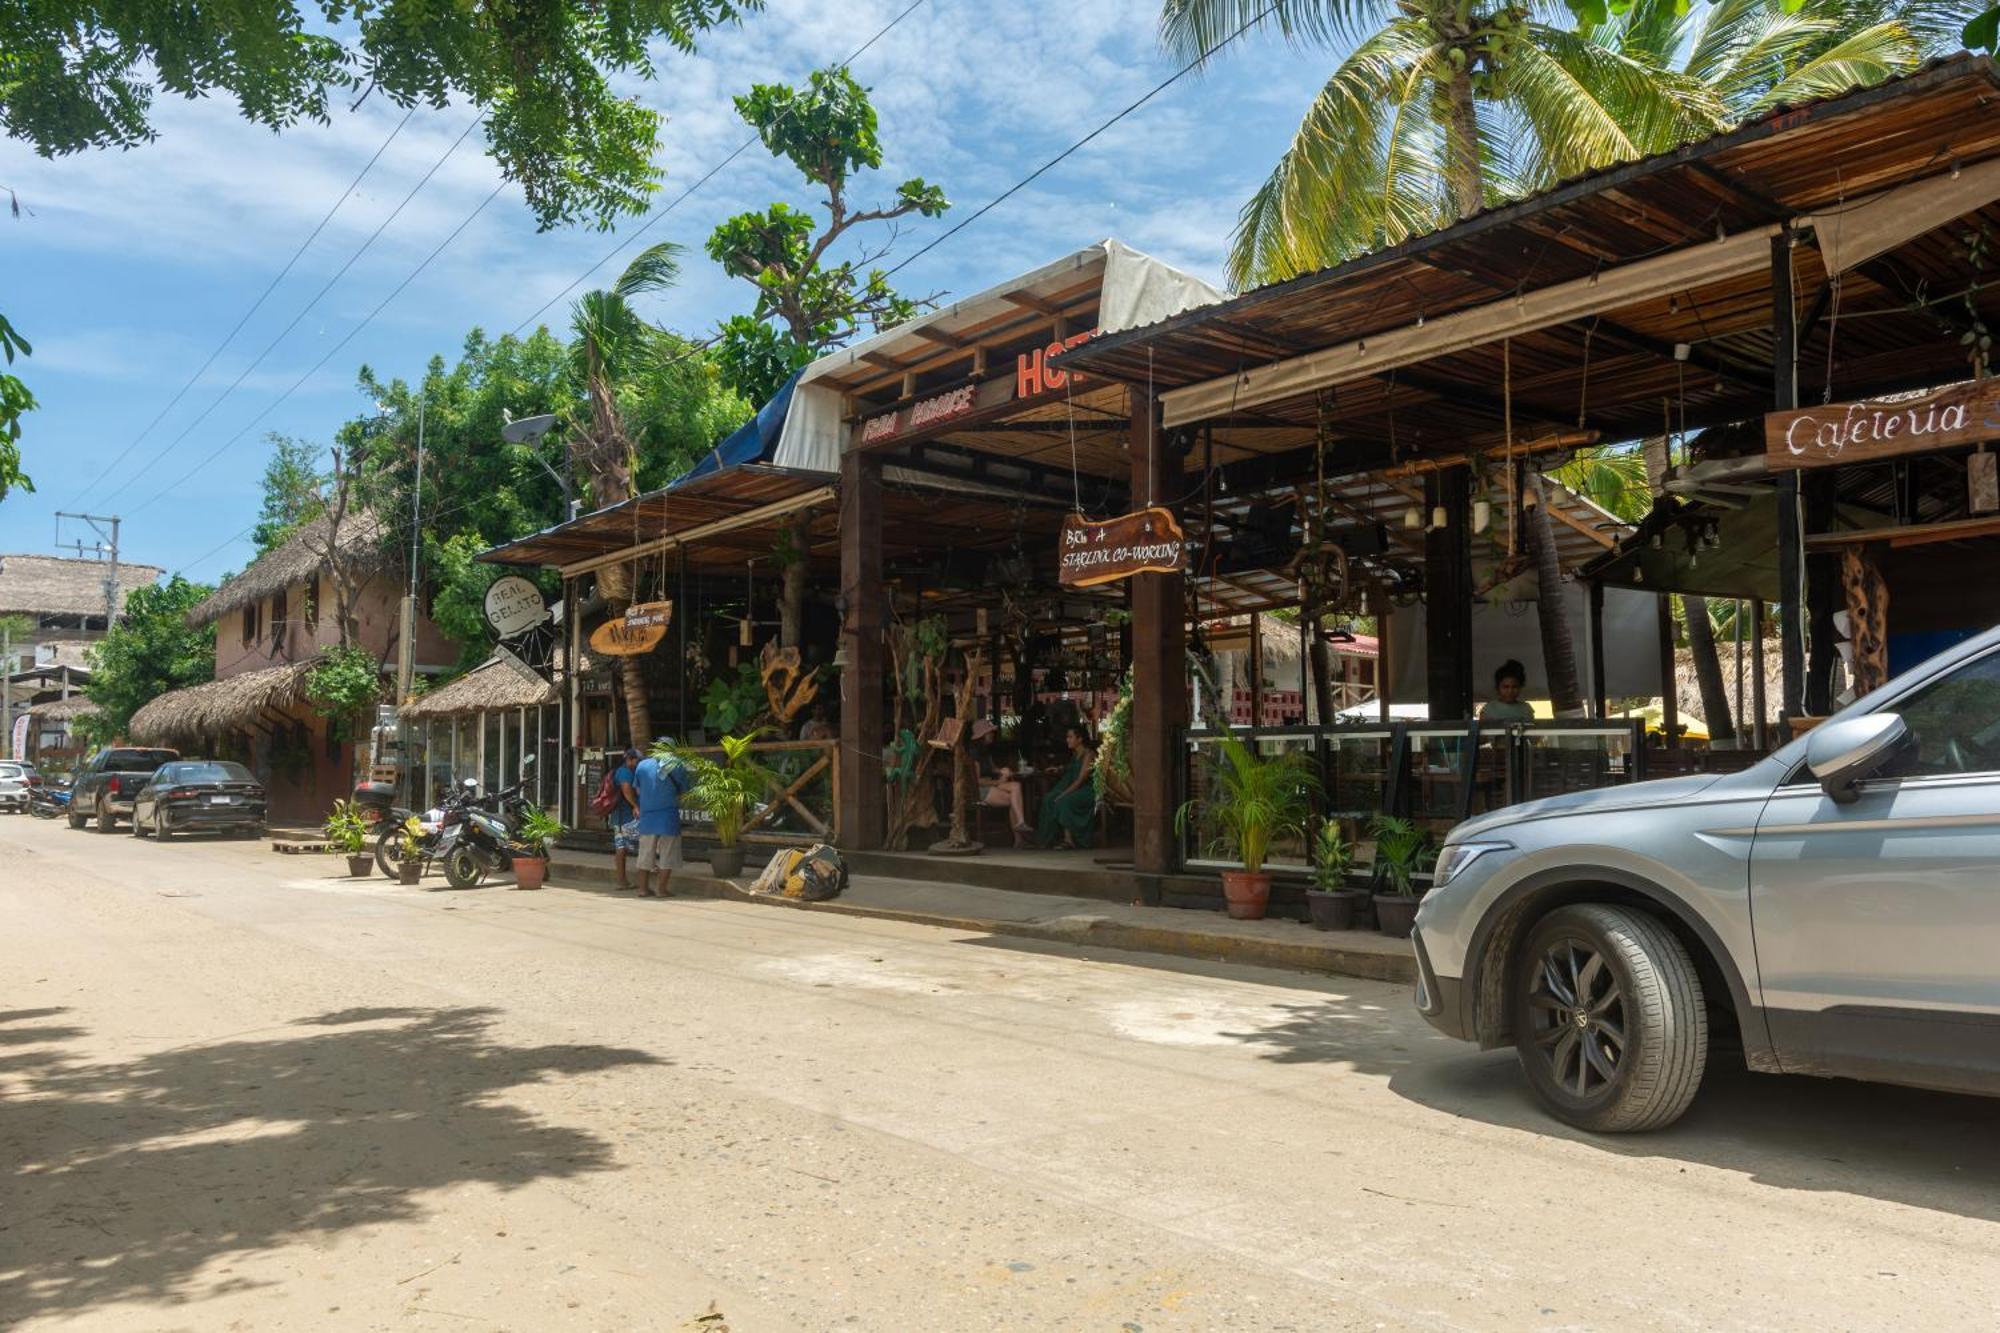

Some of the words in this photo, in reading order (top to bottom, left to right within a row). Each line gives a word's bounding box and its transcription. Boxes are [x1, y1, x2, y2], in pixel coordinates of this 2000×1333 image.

[1785, 402, 1970, 458] Cafeteria
[1062, 547, 1110, 572] STARLINK
[1112, 540, 1180, 567] CO-WORKING
[490, 593, 541, 623] GELATO
[492, 584, 525, 605] REAL
